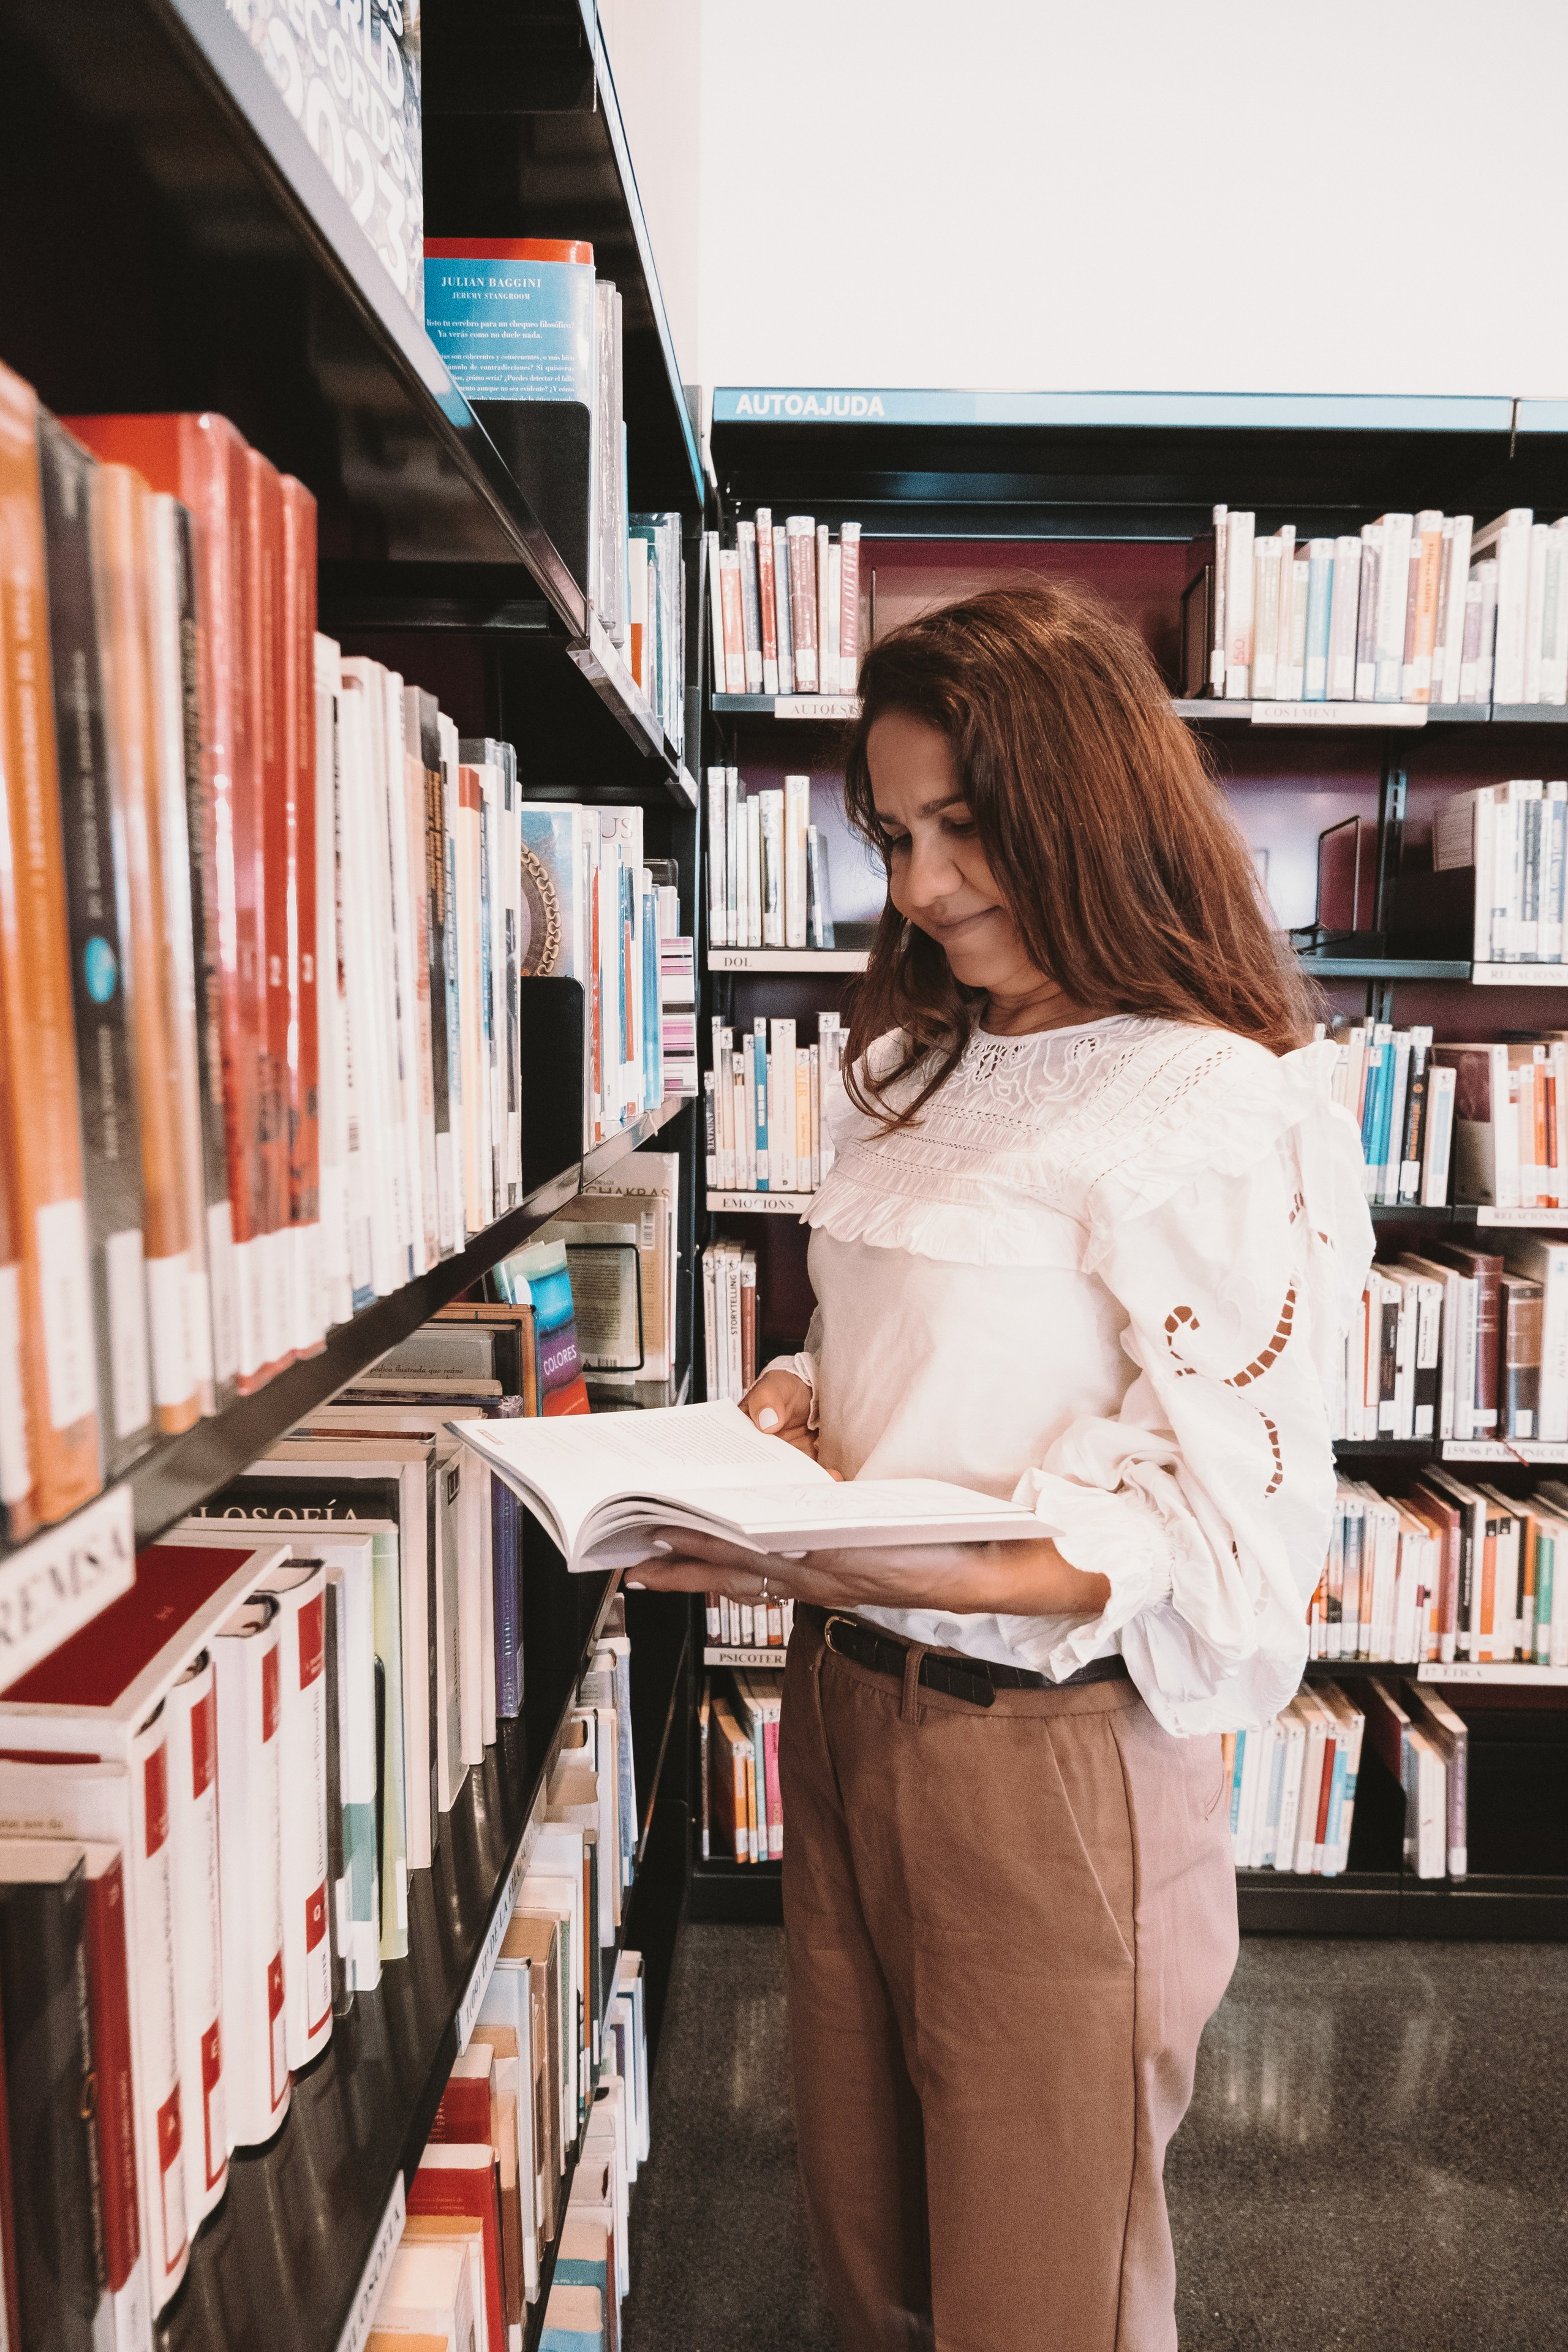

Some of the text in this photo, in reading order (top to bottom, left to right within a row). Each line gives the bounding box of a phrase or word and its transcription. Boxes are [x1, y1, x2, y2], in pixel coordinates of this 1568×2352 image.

[442, 277, 541, 288] JULIAN BAGGINI
[509, 320, 538, 329] chequeo
[540, 320, 575, 329] filosófico?
[736, 394, 885, 417] AUTOAJUDA
[791, 704, 856, 715] AUTOES
[724, 957, 752, 967] DOL
[723, 1198, 794, 1209] EMOCIONS
[729, 1274, 738, 1335] STORYTELLING
[543, 1344, 577, 1376] COLORES
[395, 1365, 426, 1373] ilustrada
[191, 1499, 358, 1520] LOSOFÍA
[489, 1926, 500, 1954] DE
[499, 1901, 508, 1929] LA
